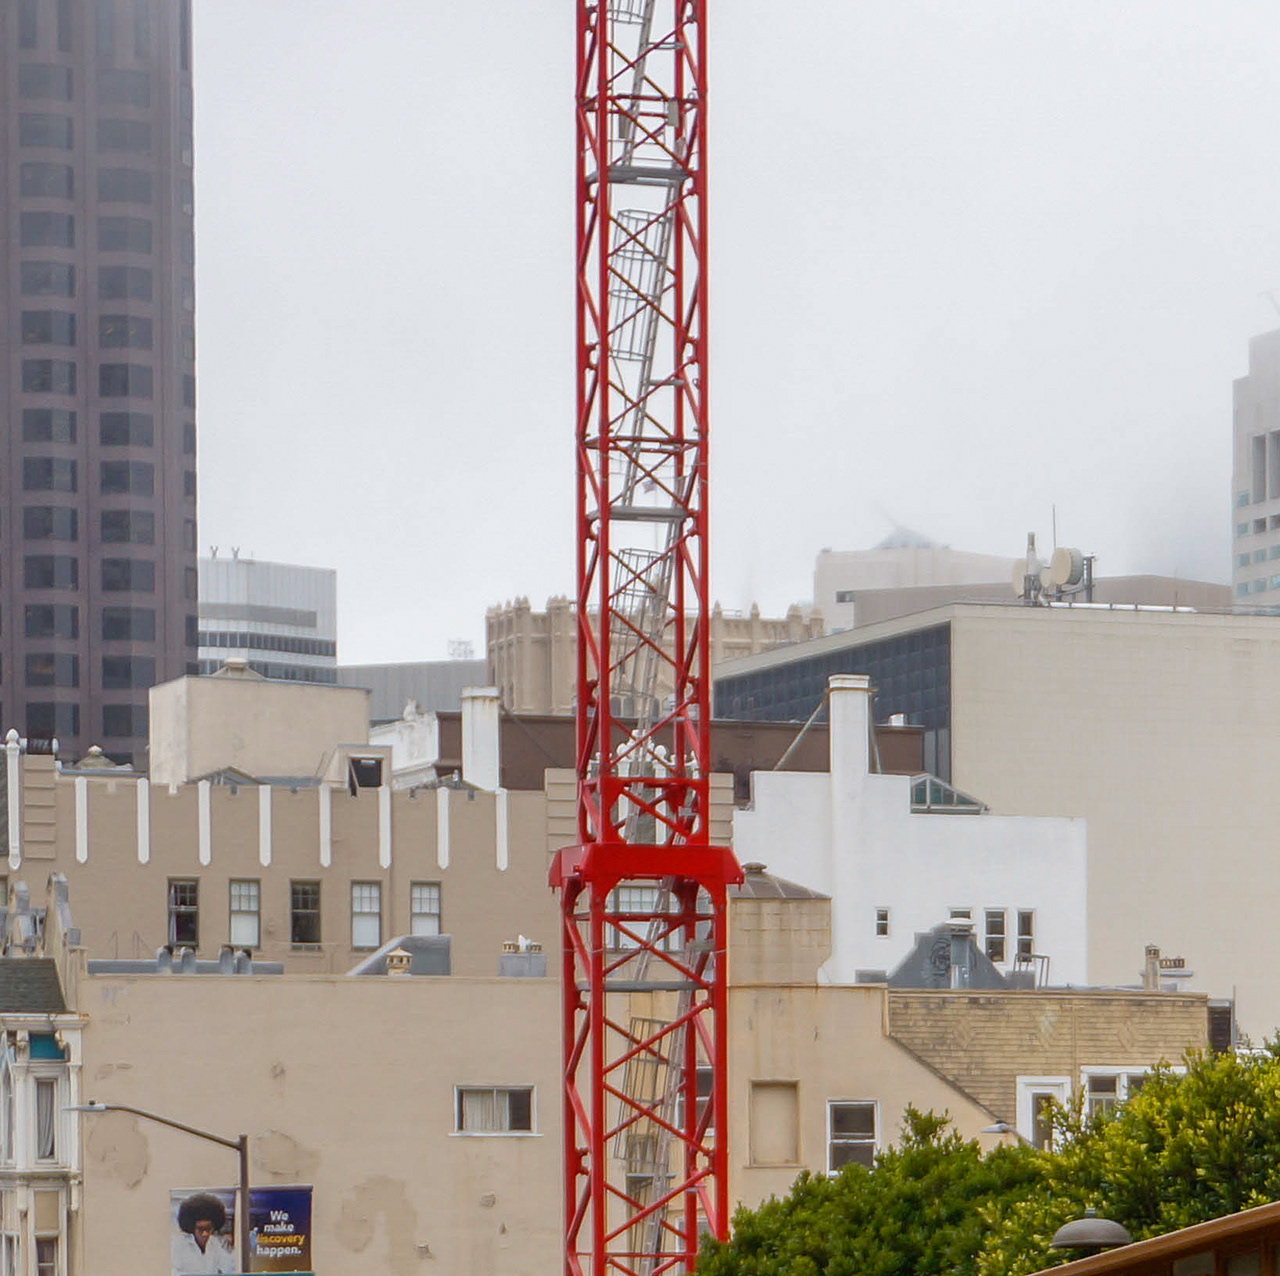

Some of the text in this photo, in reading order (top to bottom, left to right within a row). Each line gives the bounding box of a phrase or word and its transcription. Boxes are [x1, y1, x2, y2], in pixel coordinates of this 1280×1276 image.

[270, 1210, 289, 1221] We
[263, 1222, 295, 1233] make
[256, 1244, 302, 1258] happen.
